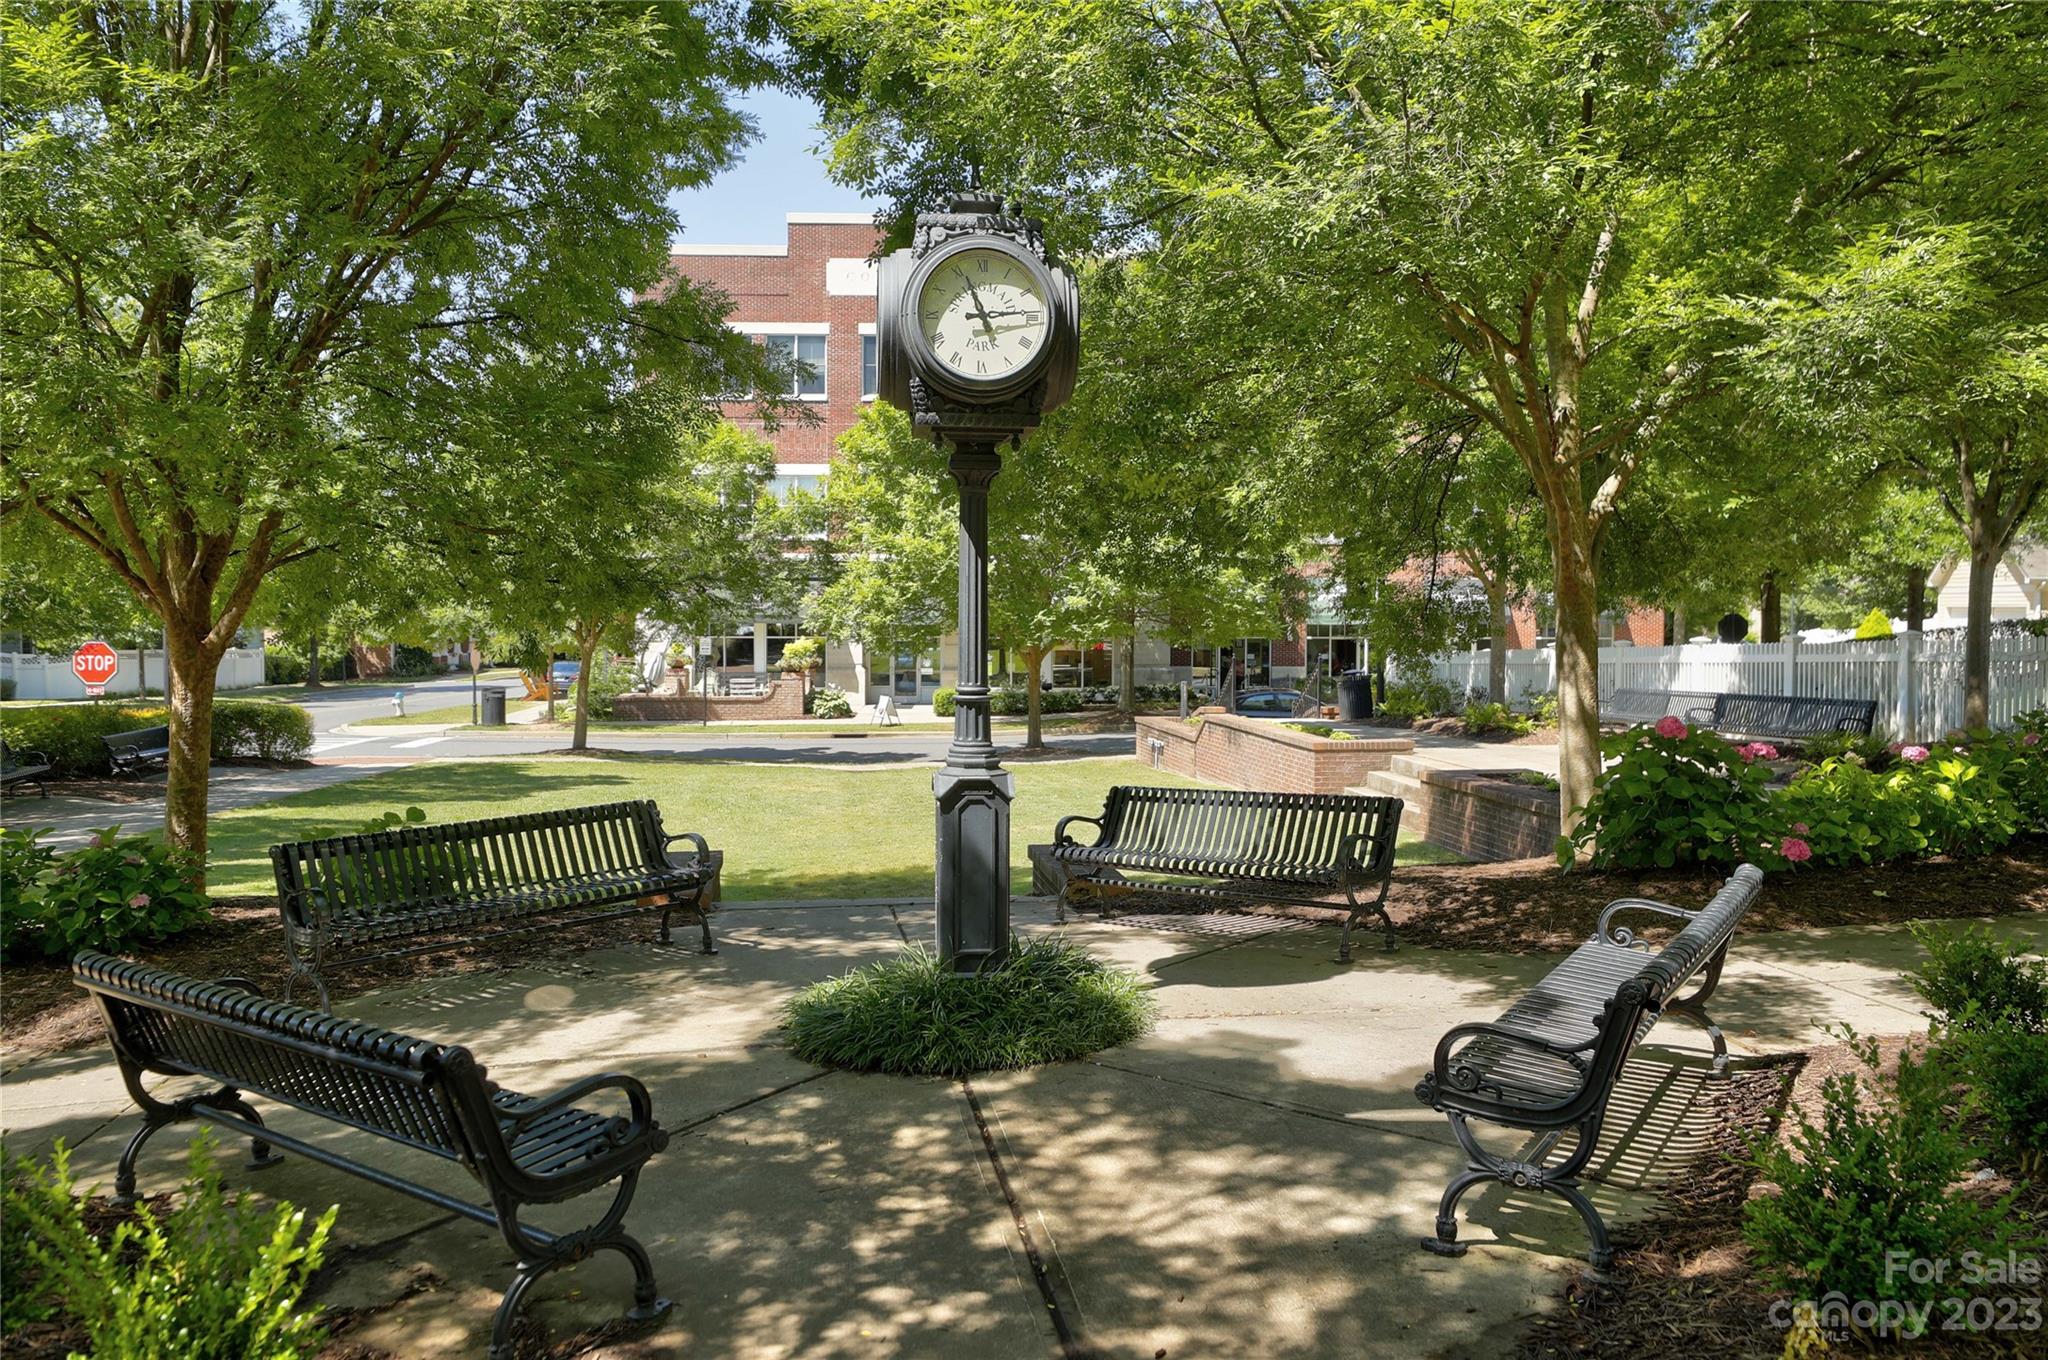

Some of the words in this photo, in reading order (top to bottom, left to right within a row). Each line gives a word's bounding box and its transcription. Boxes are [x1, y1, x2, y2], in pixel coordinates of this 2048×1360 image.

[976, 259, 988, 272] XII
[966, 338, 999, 351] PARK
[976, 360, 988, 373] VI
[76, 655, 114, 671] STOP
